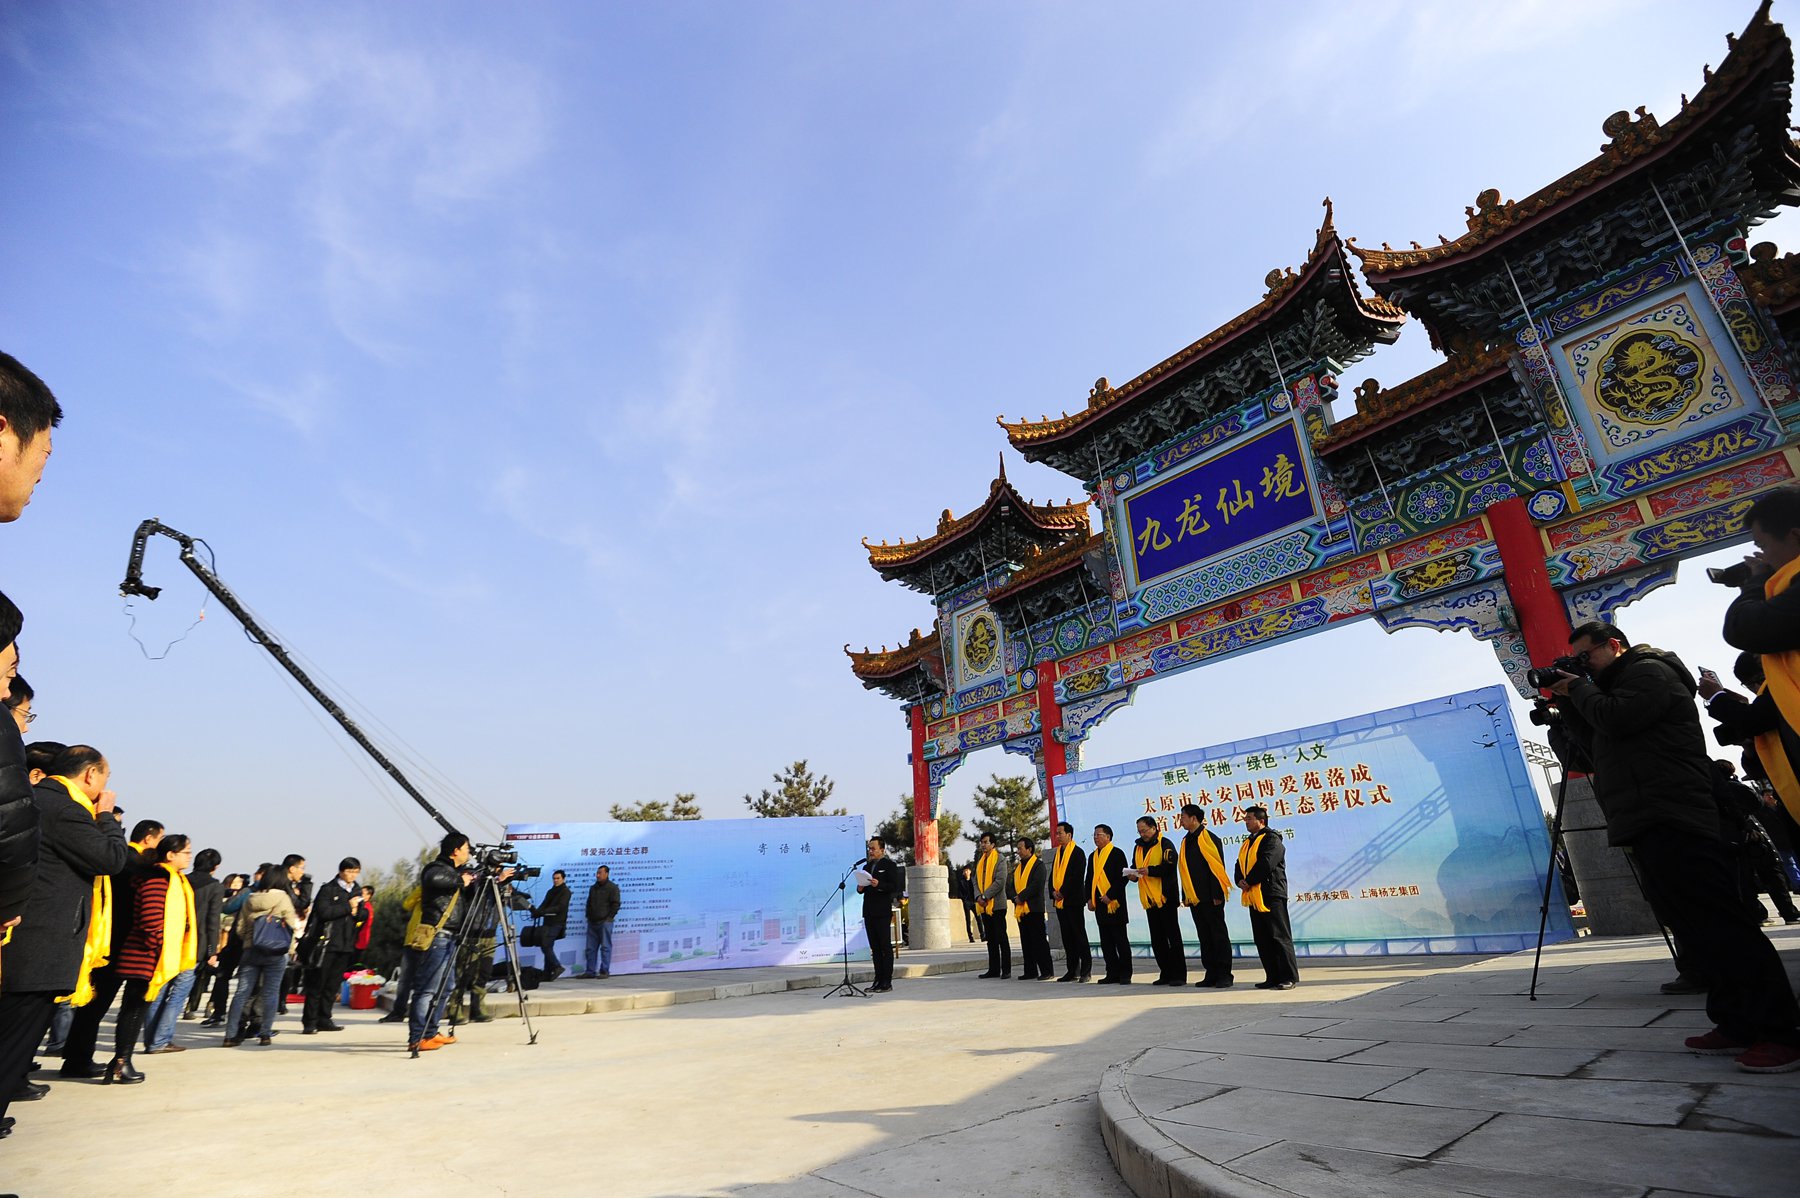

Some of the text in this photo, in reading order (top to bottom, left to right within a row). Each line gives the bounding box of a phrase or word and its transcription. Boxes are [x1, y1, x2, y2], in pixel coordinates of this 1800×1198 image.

[1138, 454, 1305, 556] 九龙仙境
[1142, 763, 1372, 814] 太原市永安园博爱苑落成
[581, 847, 648, 856] 博爱苑公益生态葬
